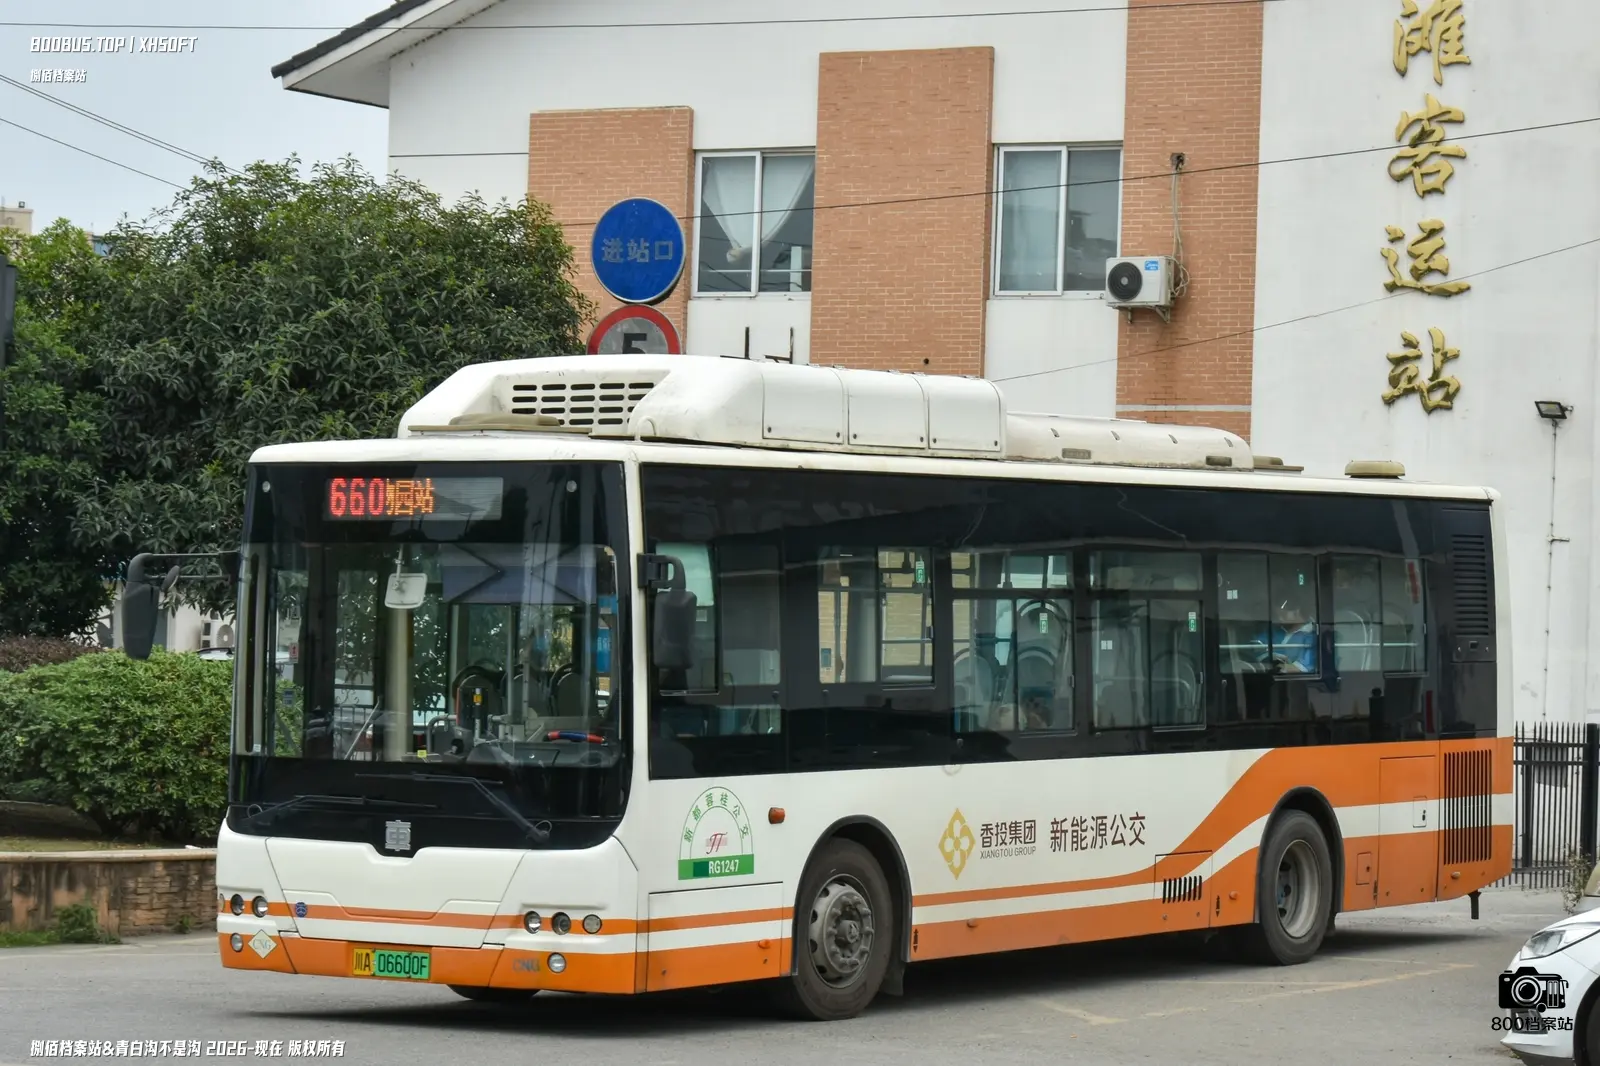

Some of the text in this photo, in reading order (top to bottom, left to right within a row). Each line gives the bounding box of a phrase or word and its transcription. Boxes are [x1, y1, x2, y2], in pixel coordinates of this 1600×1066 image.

[602, 238, 673, 263] 进站口
[330, 478, 385, 516] 660
[980, 811, 1146, 853] 香投集团 新能源公交
[980, 846, 1037, 860] XIANGTOU GROUP
[708, 859, 740, 875] RG1247
